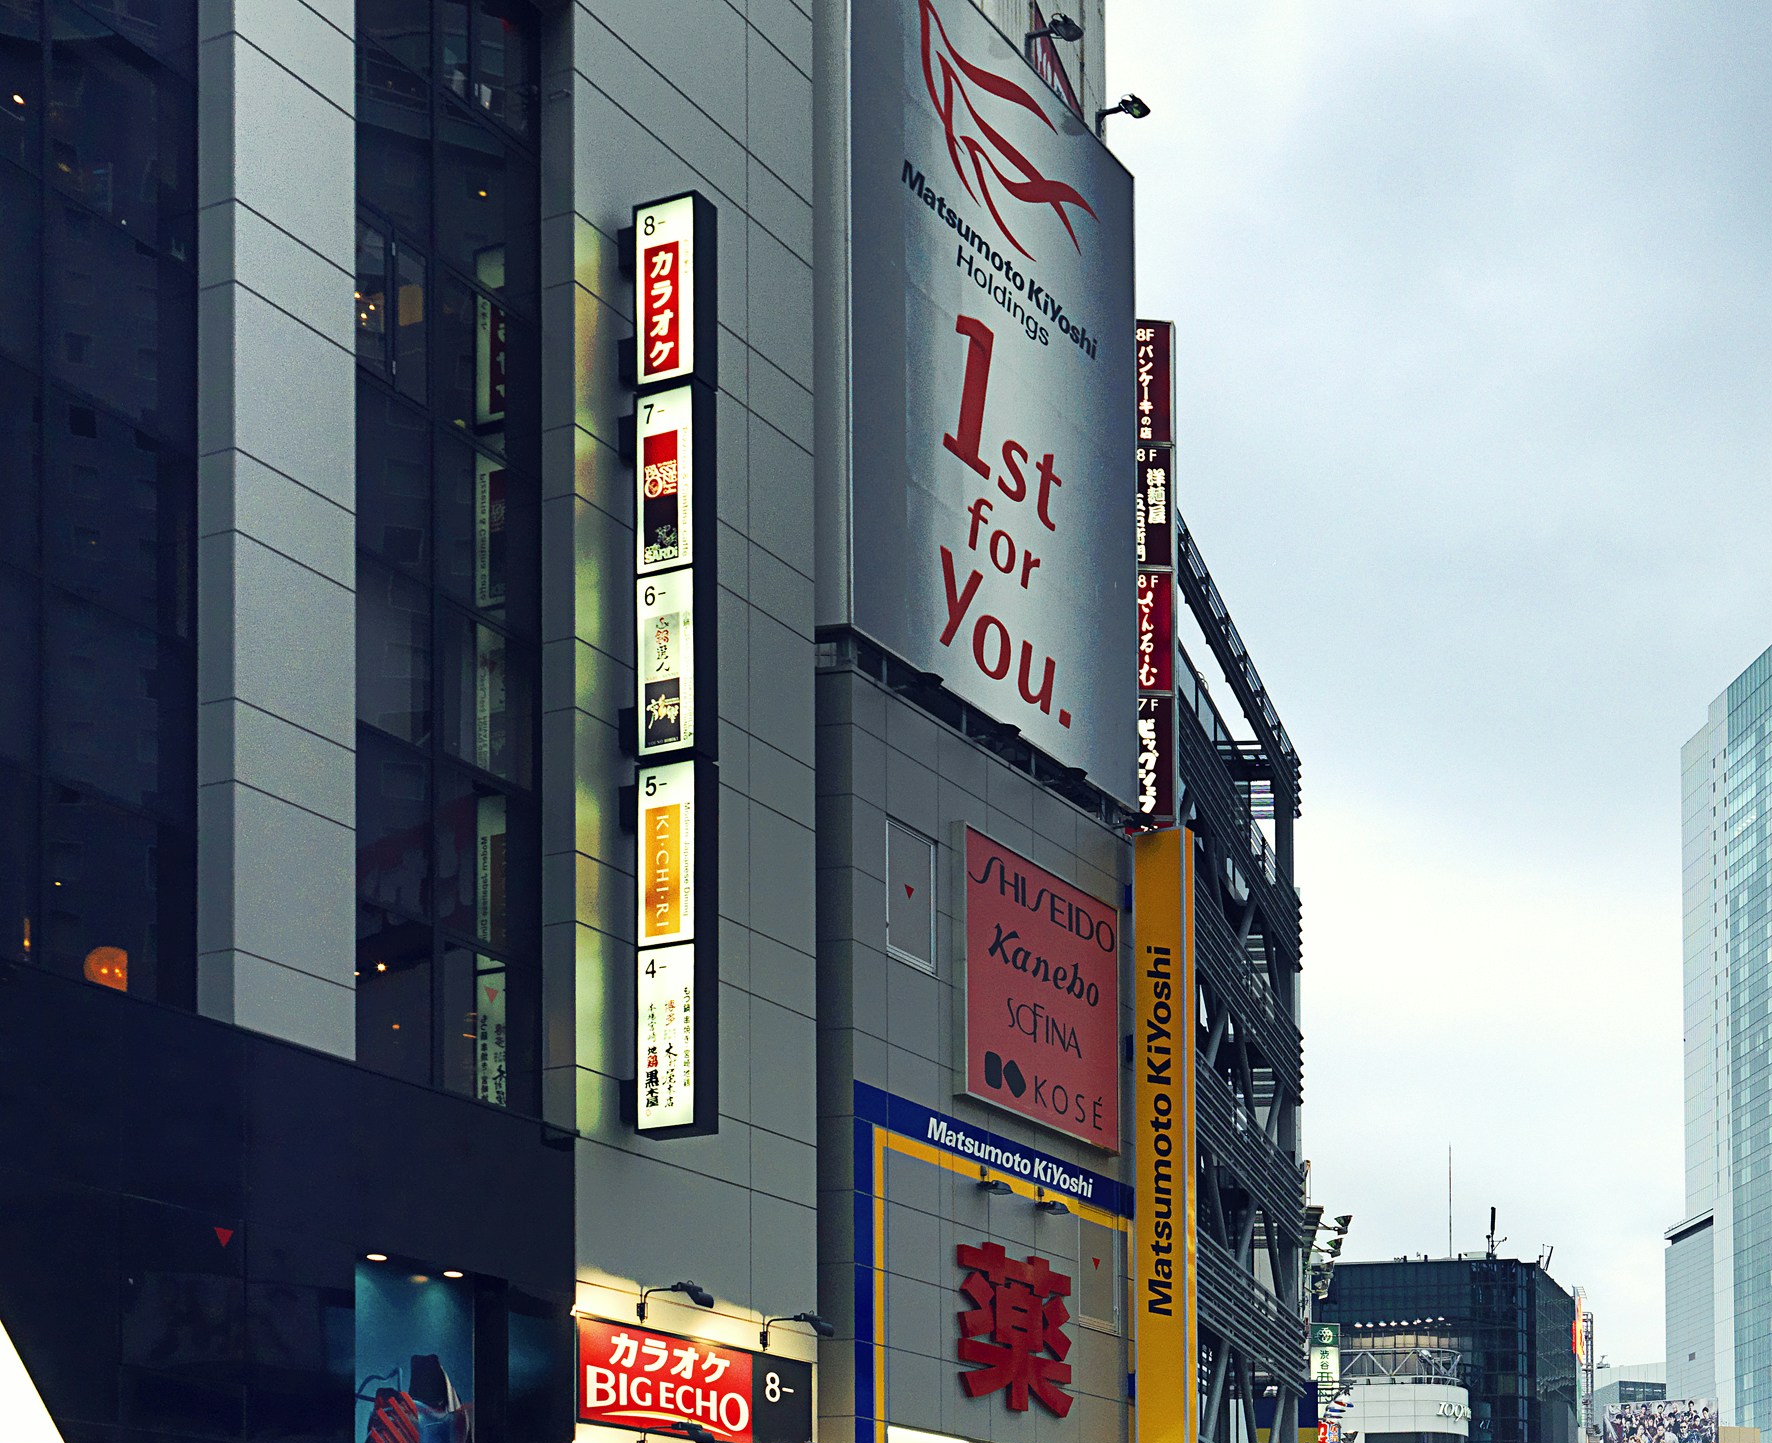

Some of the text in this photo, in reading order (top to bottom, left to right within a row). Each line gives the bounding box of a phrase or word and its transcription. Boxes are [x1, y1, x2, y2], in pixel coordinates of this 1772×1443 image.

[901, 159, 1098, 361] Matsumoto KiYoshi
[956, 245, 1052, 349] Holdings
[650, 251, 674, 367] カラオケ
[1136, 328, 1154, 342] 8F
[943, 314, 1064, 532] 1st
[1138, 345, 1154, 440] パンケーキの店
[967, 498, 1041, 591] for
[1137, 575, 1159, 588] 8F
[938, 545, 1071, 729] you.
[968, 857, 1116, 953] SHISEIDO
[988, 923, 1099, 1007] Kanebo
[1007, 997, 1082, 1059] SOFINA
[1034, 1075, 1103, 1131] KOSÉ
[1146, 945, 1173, 1317] Matsumoto KiYoshi
[927, 1117, 1094, 1199] Matsumoto KiYoshi
[609, 1331, 730, 1384] カラオケ
[957, 1241, 1074, 1418] 薬
[586, 1364, 750, 1433] BIG ECHO
